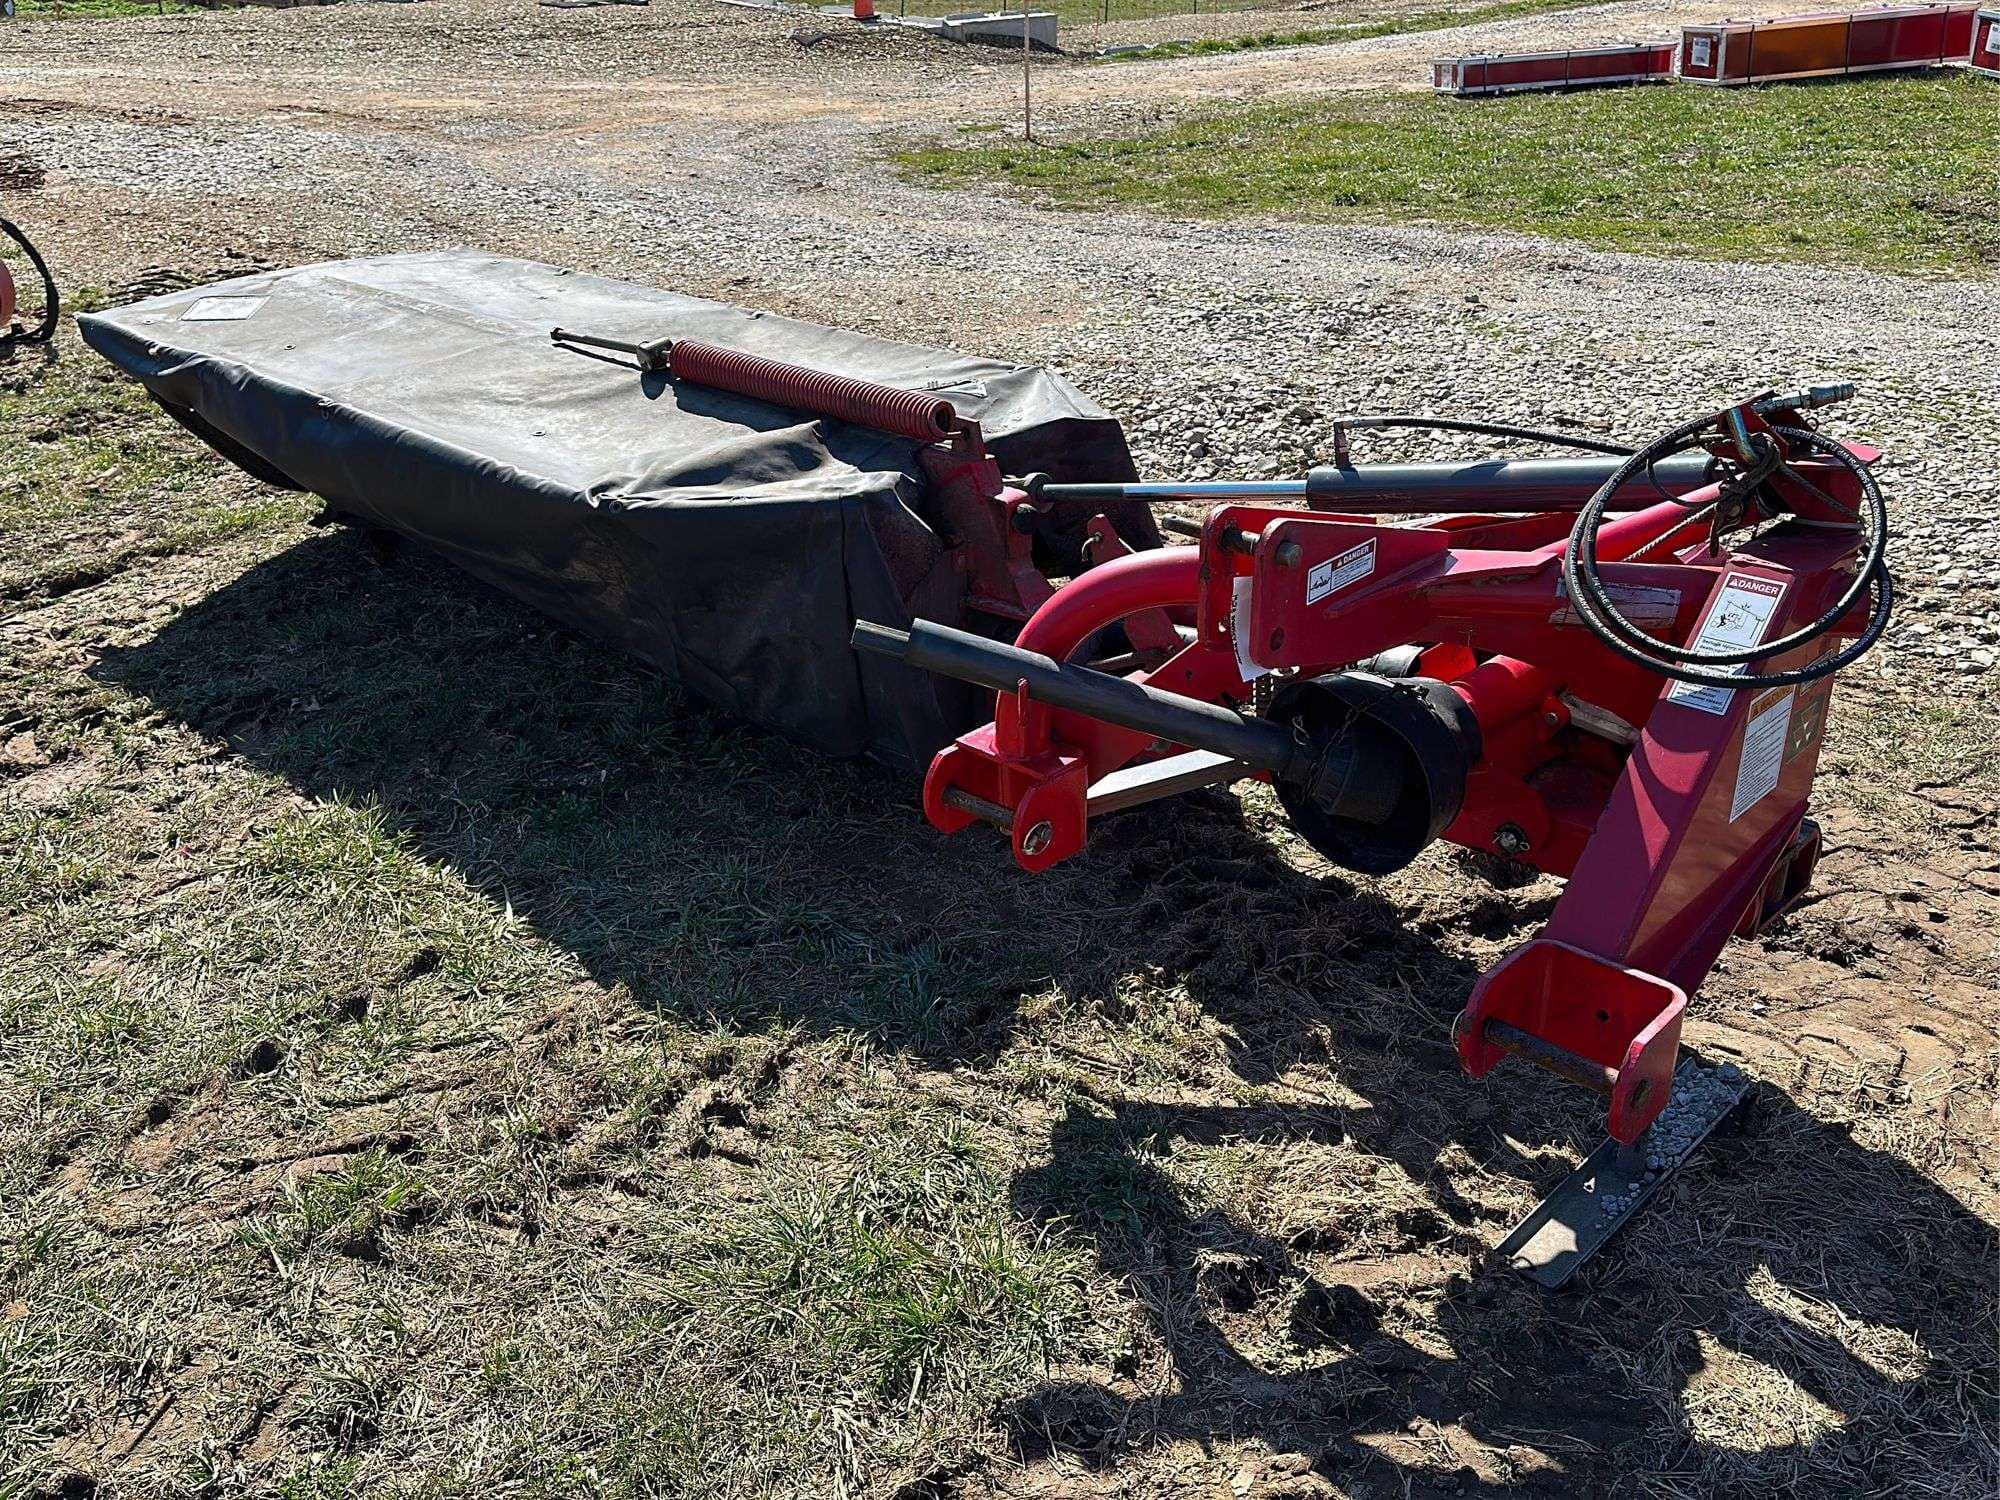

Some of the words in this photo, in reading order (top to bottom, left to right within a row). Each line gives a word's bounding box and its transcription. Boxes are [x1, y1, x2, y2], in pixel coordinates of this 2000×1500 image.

[1810, 433, 1838, 452] FLAME
[1846, 456, 1860, 470] PSI
[1343, 545, 1369, 565] DANGER
[1571, 573, 1590, 612] RESISTANT
[1597, 588, 1609, 604] SAE
[1738, 580, 1779, 595] DANGER
